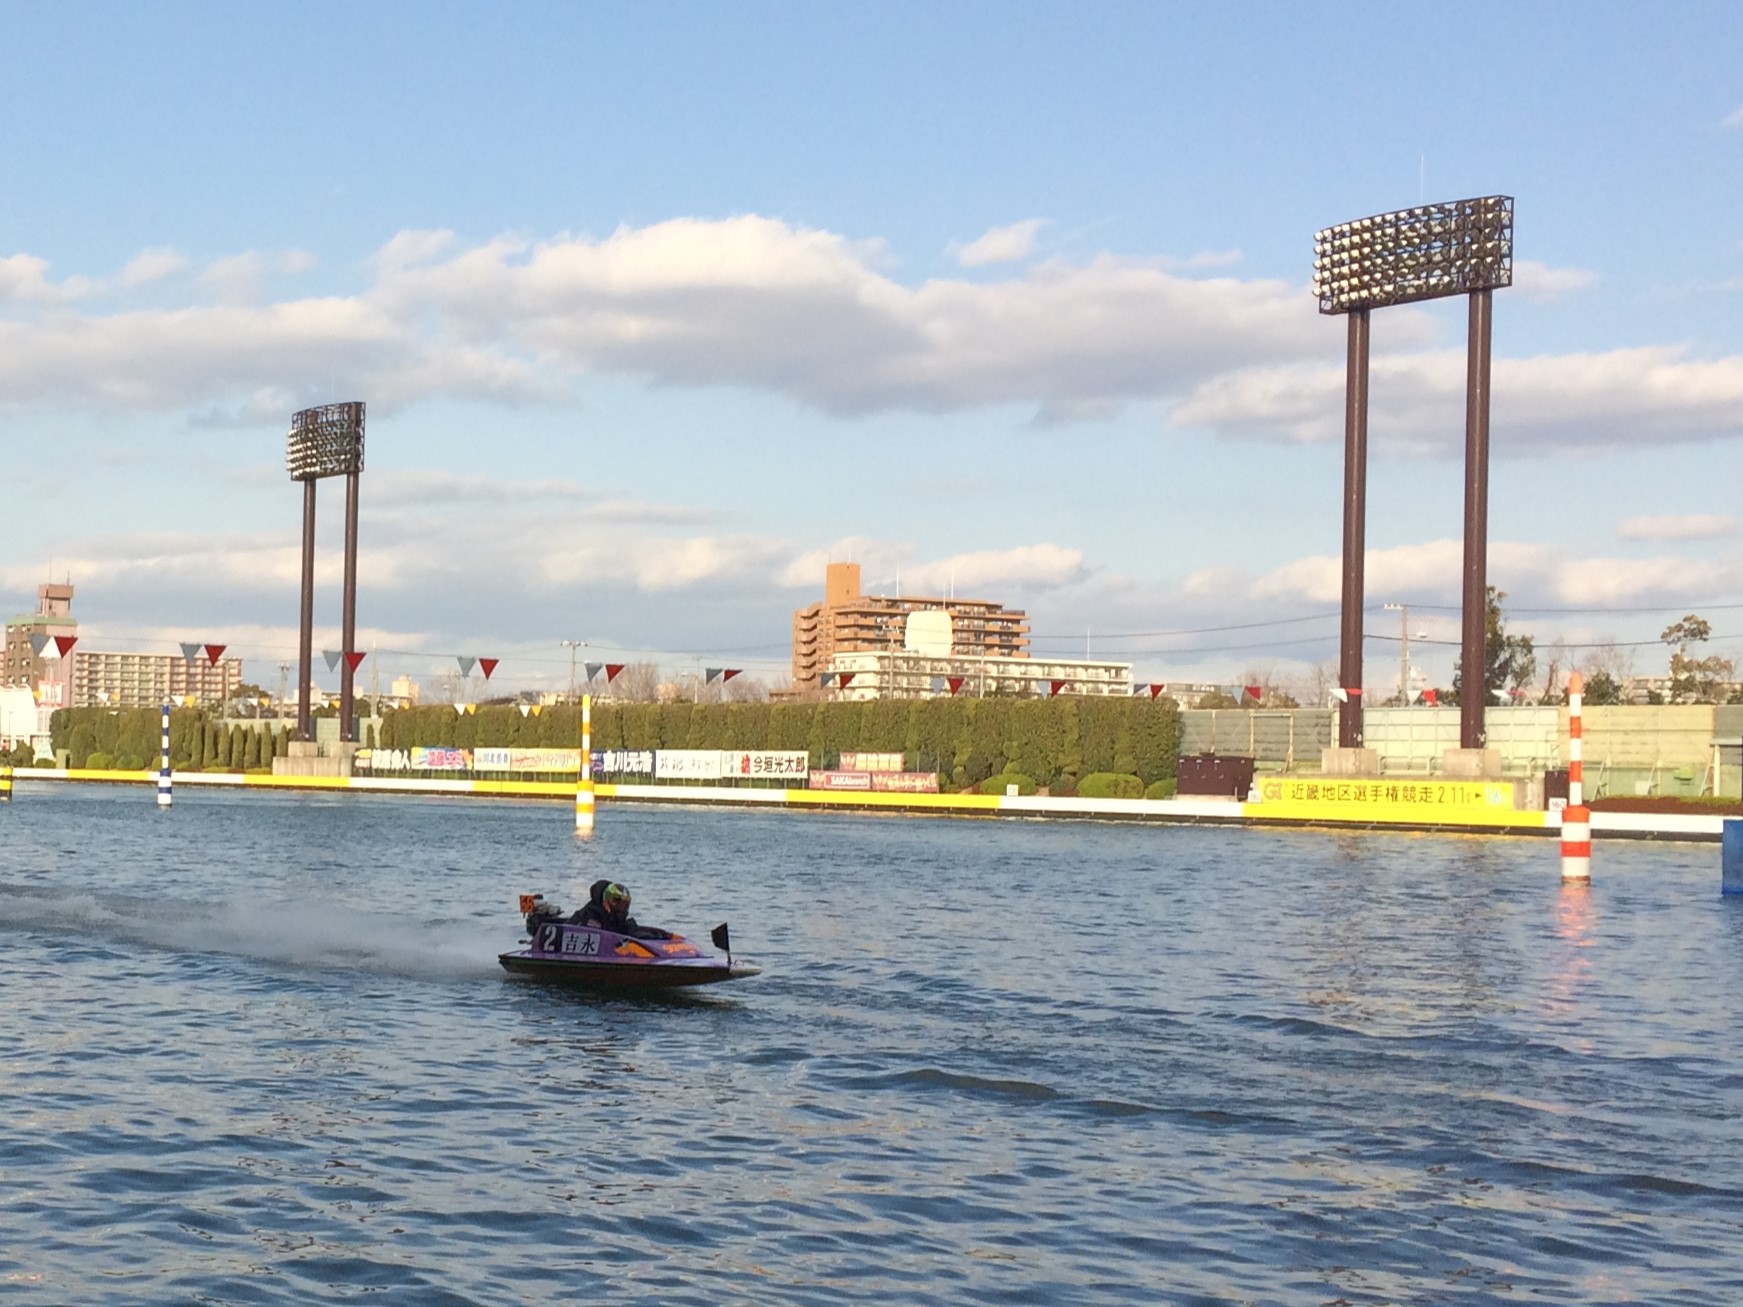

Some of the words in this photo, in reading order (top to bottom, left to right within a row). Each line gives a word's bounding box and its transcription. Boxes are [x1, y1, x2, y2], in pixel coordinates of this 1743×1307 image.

[603, 750, 653, 773] 吉川元浩
[753, 755, 806, 773] 今垣光太郎
[543, 926, 557, 951] 2
